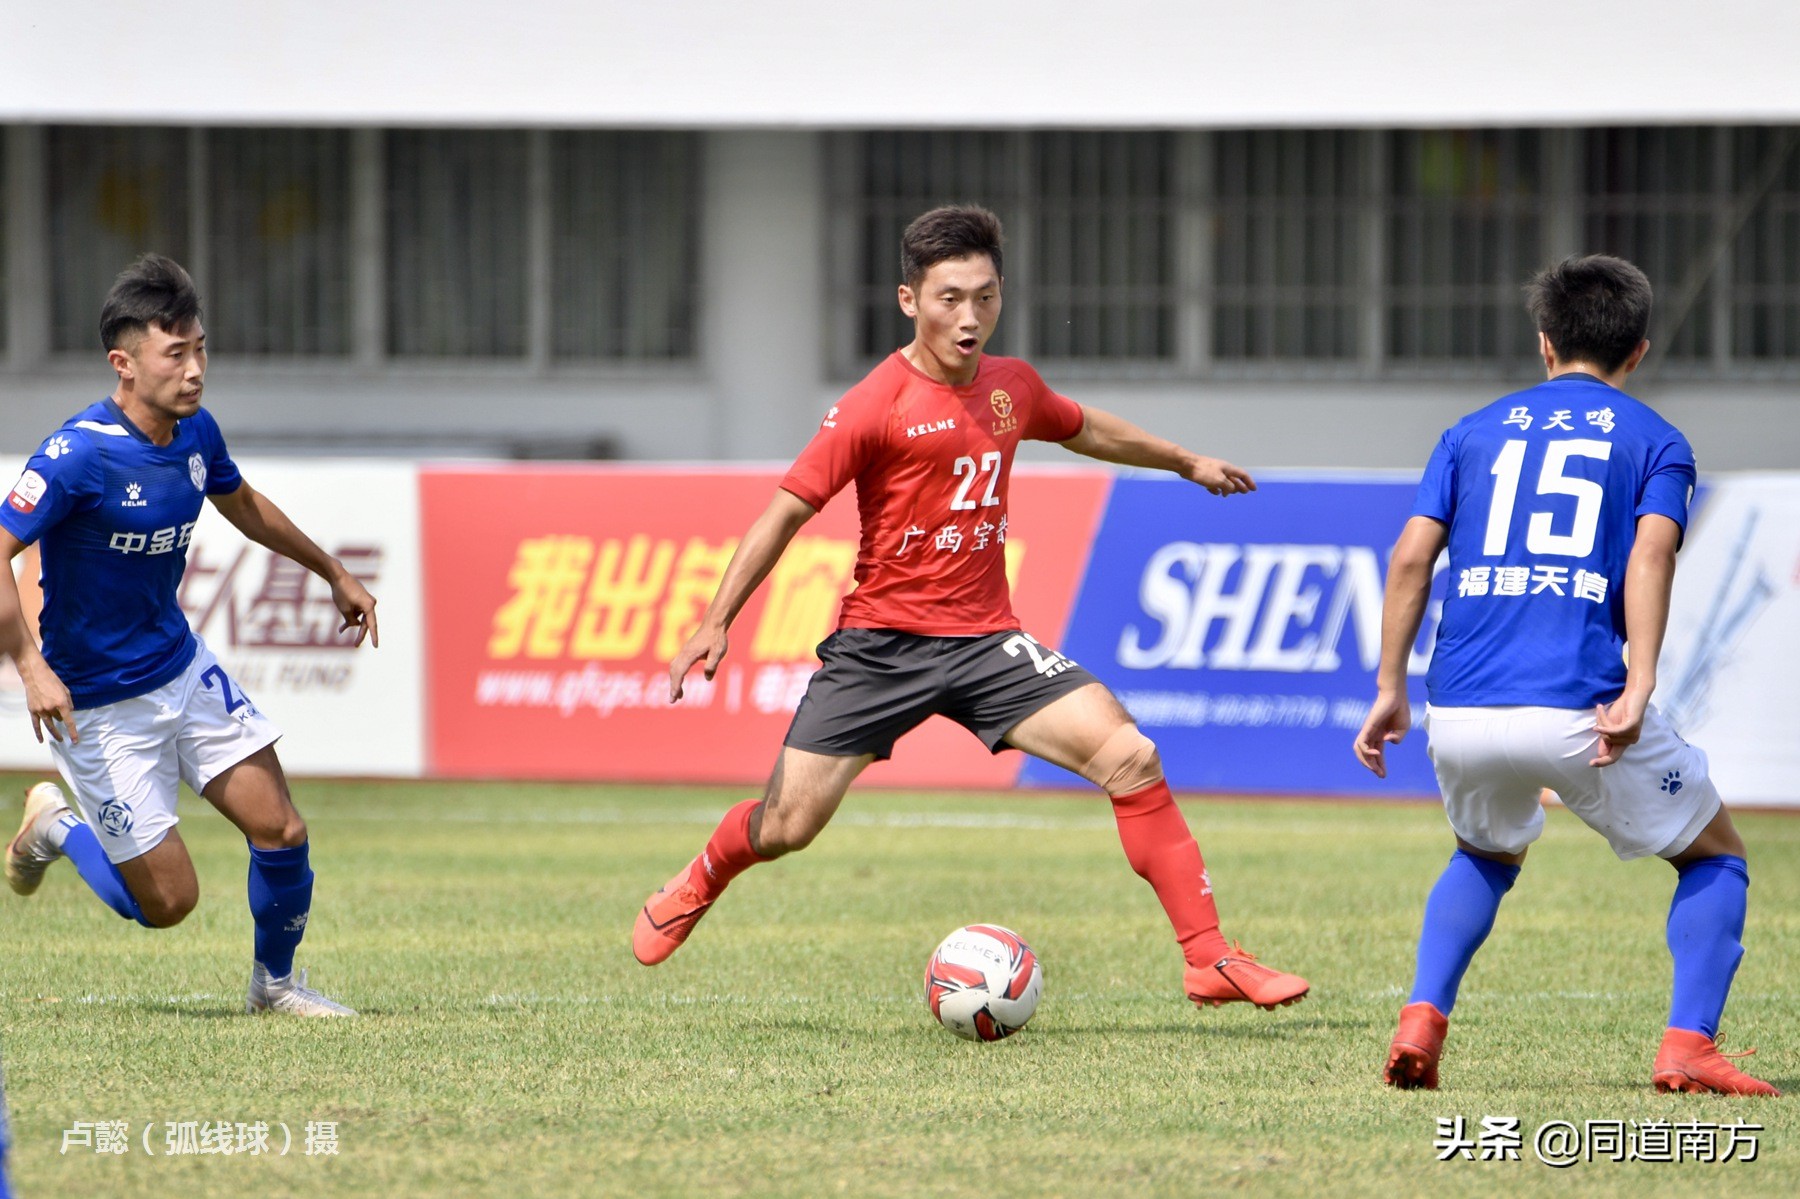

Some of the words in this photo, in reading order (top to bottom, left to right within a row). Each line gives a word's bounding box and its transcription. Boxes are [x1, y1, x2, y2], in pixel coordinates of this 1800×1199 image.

[907, 418, 956, 437] KELME
[1502, 406, 1616, 433] 马天鸣
[949, 451, 1002, 511] 22
[1482, 439, 1612, 558] 15
[1457, 566, 1608, 604] 福建天信
[200, 664, 252, 715] 2
[946, 940, 995, 960] KELME
